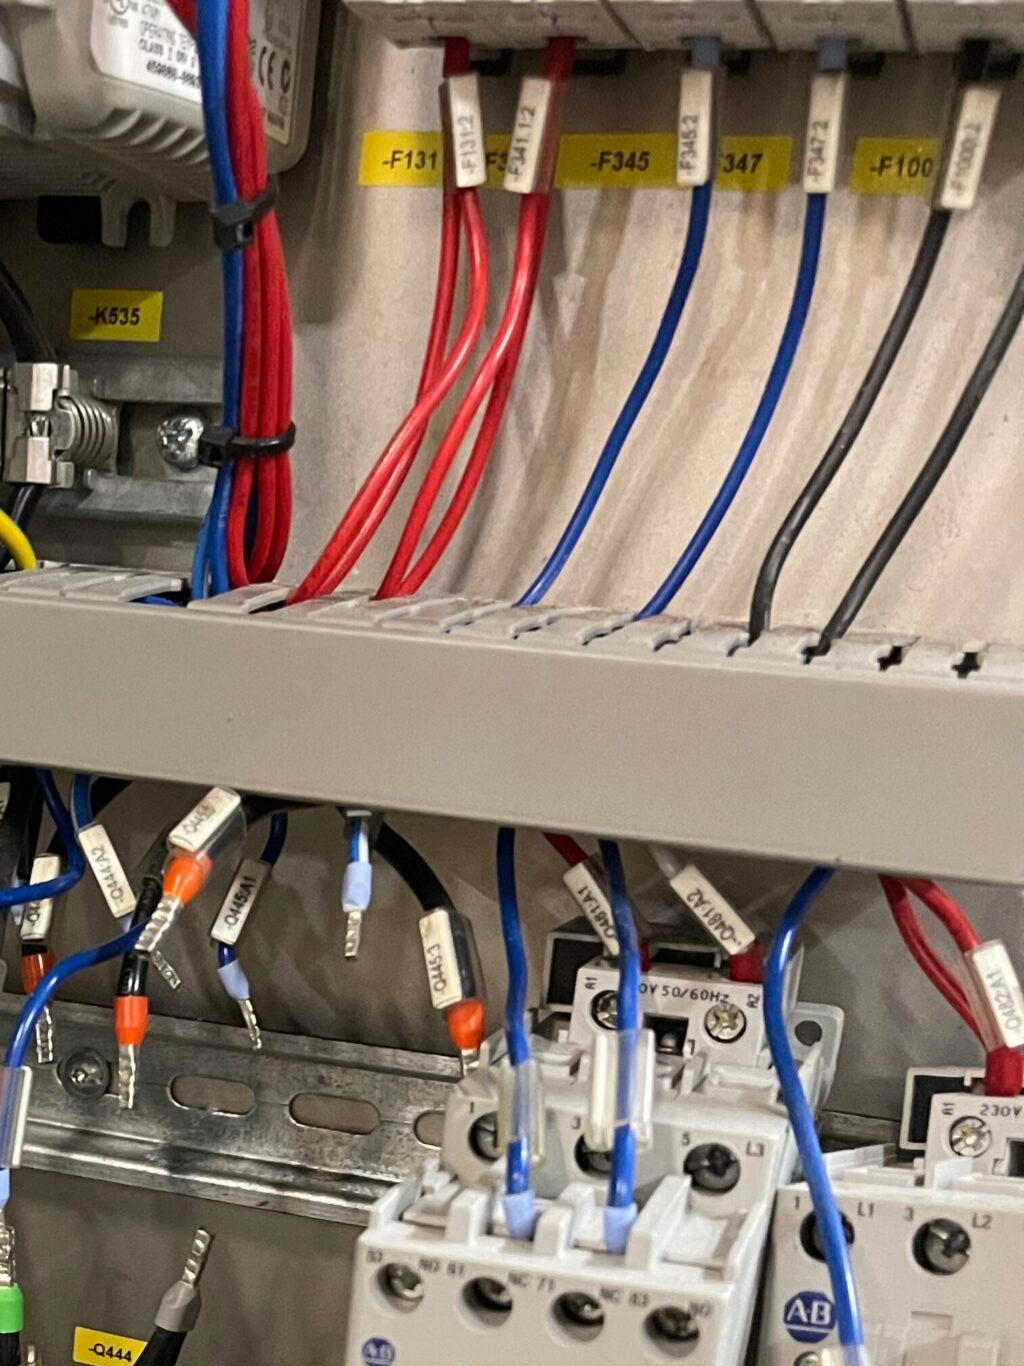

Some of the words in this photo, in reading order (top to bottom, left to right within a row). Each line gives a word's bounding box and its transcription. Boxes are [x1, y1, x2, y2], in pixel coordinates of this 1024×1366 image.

[458, 113, 475, 175] -F131:2
[590, 151, 650, 172] -F345
[720, 152, 763, 174] 347
[88, 305, 141, 328] -K535
[91, 844, 126, 906] -Q444:A2
[224, 875, 257, 930] -Q445:A1
[586, 976, 597, 990] A1
[660, 986, 730, 1005] 50/60Hz
[746, 993, 761, 1009] A2
[941, 1102, 955, 1116] A1
[978, 1103, 1023, 1118] 230V
[745, 1140, 765, 1157] L3
[857, 1202, 875, 1218] L1
[903, 1206, 915, 1221] 3
[972, 1213, 993, 1230] L2
[88, 1343, 133, 1363] -Q444
